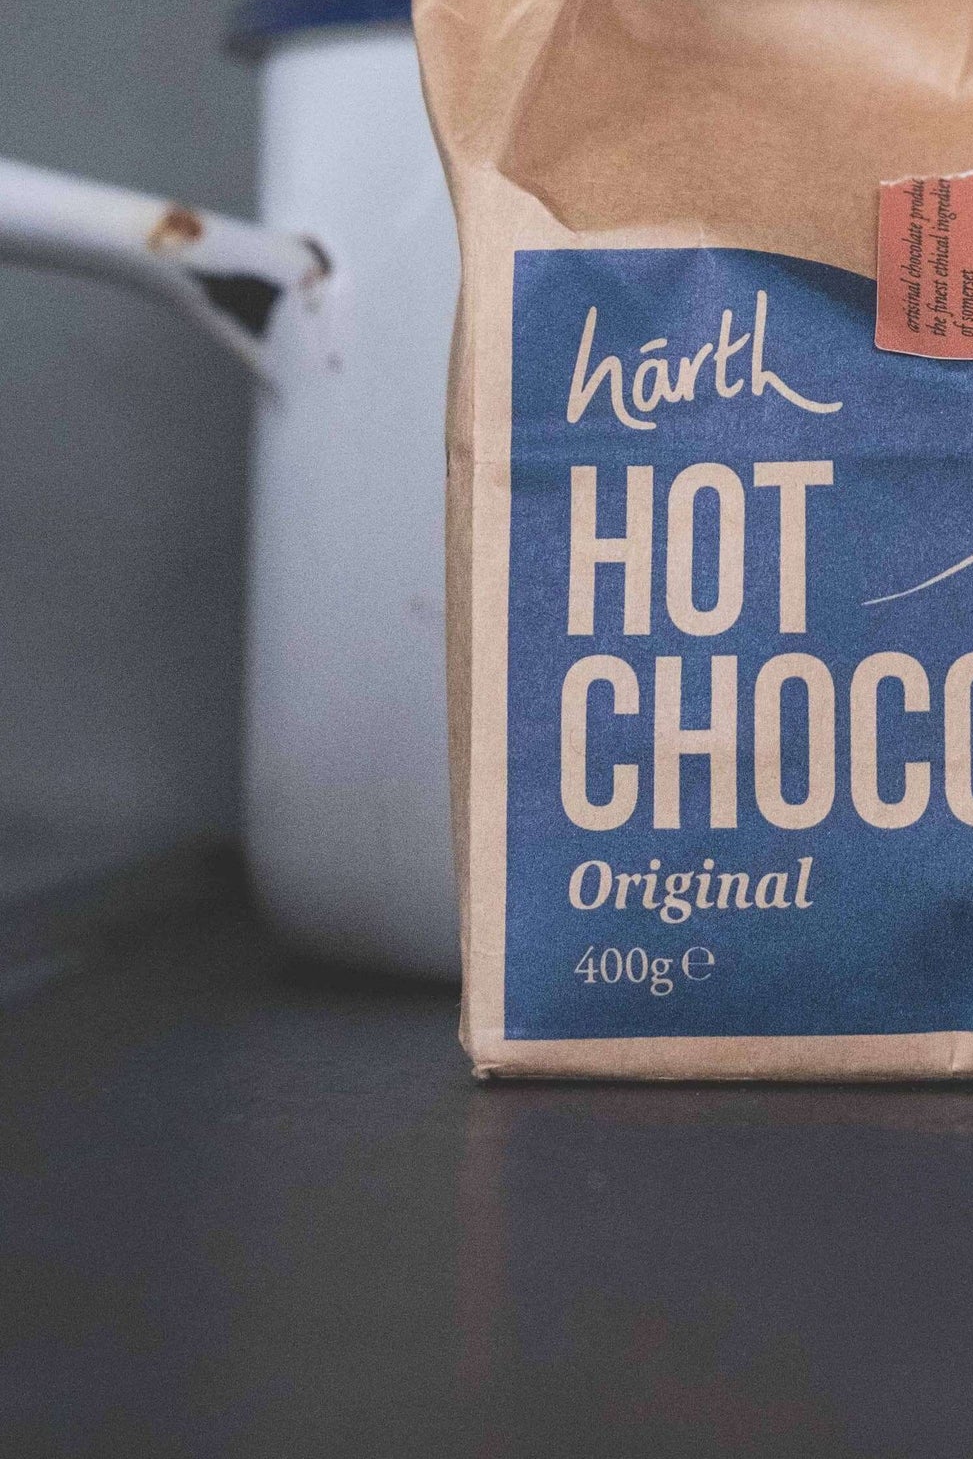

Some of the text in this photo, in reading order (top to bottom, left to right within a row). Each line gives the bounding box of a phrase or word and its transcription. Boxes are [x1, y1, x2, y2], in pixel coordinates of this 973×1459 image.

[901, 222, 923, 278] chocolate
[929, 235, 951, 278] ethical
[927, 280, 954, 317] finest
[926, 316, 947, 337] the
[567, 460, 834, 637] HOT
[568, 857, 814, 924] Original
